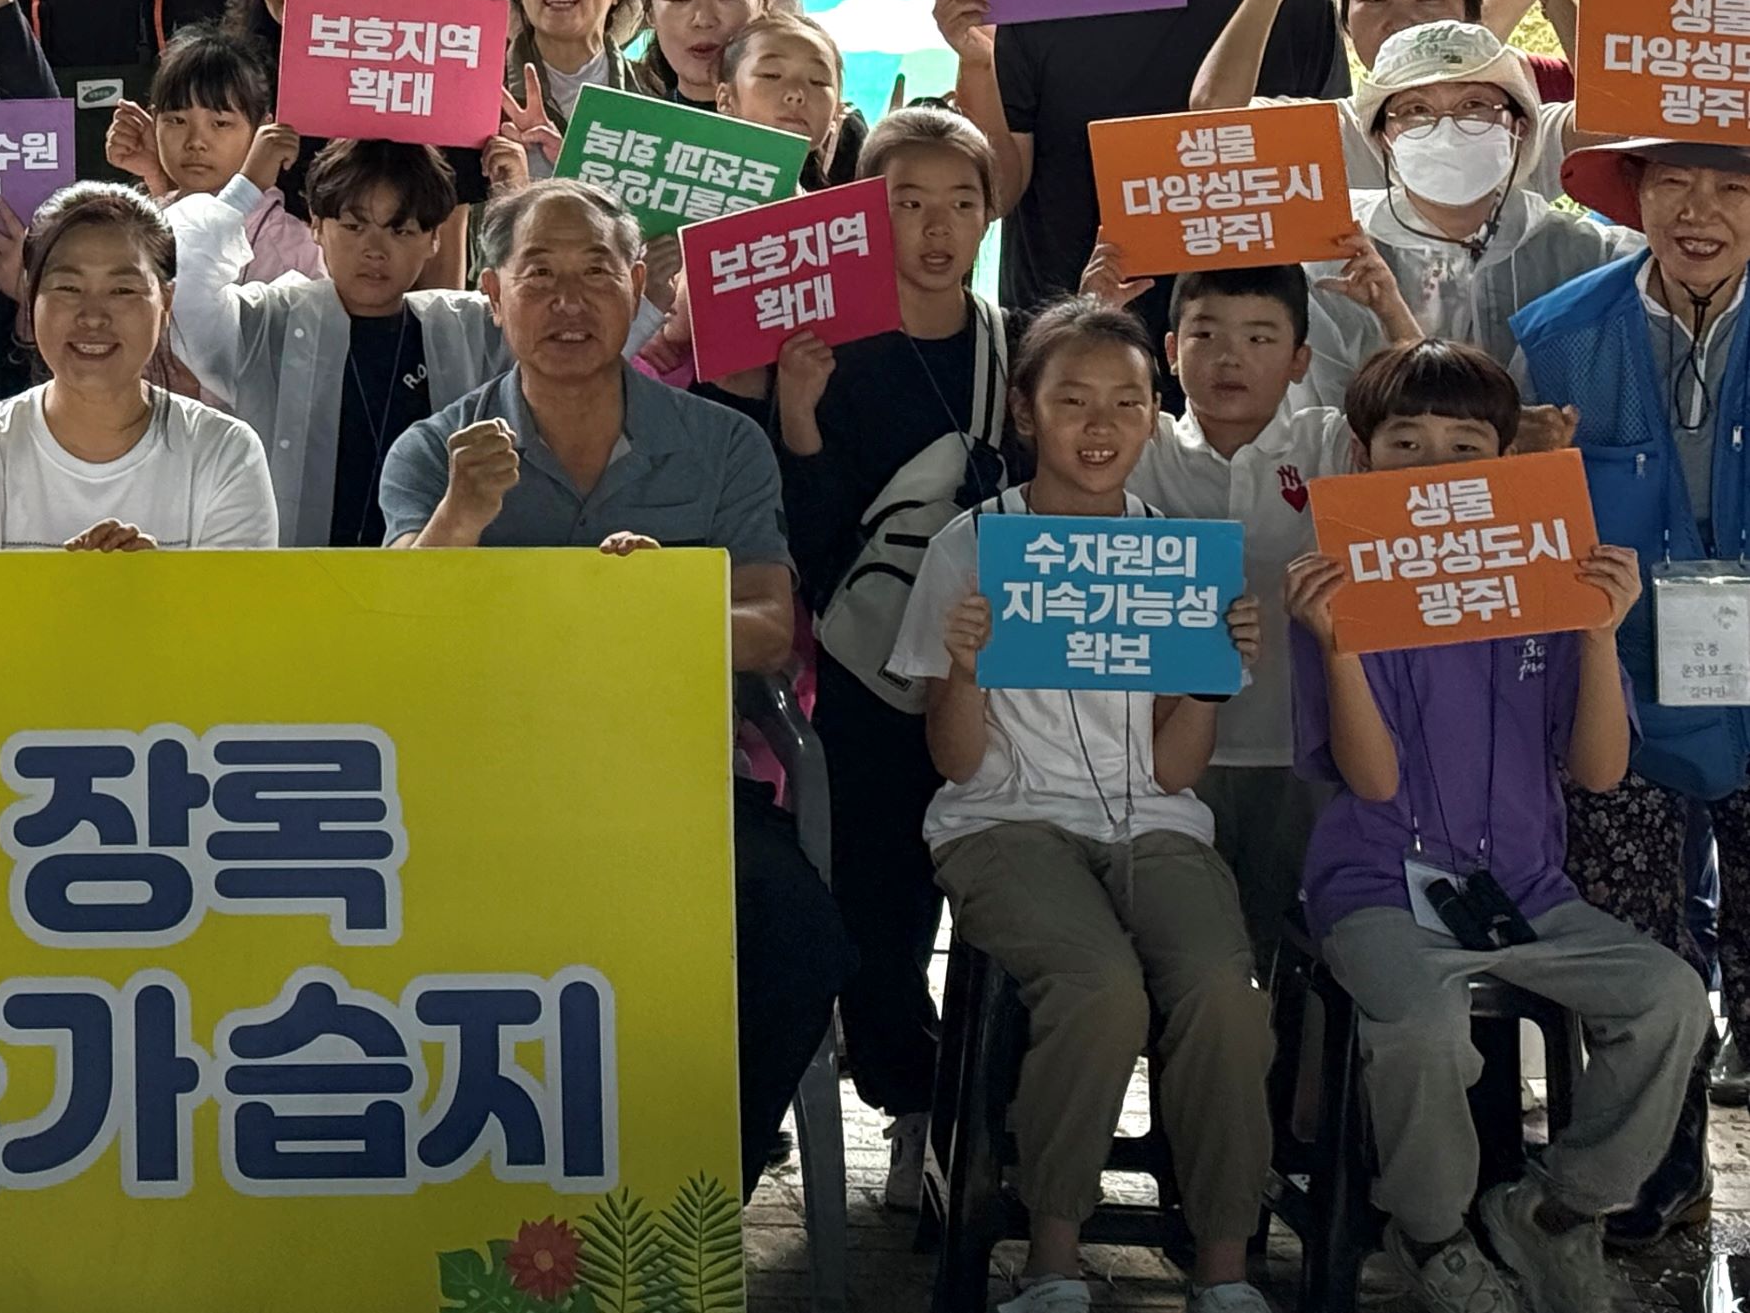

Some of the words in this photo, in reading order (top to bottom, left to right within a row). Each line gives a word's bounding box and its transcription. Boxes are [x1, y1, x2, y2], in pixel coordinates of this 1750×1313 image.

[308, 14, 481, 68] 보호지역
[348, 67, 434, 116] 확대
[1660, 84, 1750, 127] 광주
[1177, 125, 1256, 167] 생물
[1122, 164, 1323, 215] 다양성도시
[710, 212, 869, 294] 보호지역
[1181, 212, 1275, 255] 광주!
[755, 273, 835, 329] 확대
[1406, 478, 1495, 526] 생물
[1024, 533, 1197, 578] 수자원의
[1349, 519, 1572, 582] 다양성도시
[1003, 582, 1218, 627] 지속가능성
[1416, 575, 1521, 626] 광주!
[1066, 631, 1151, 675] 확보
[13, 738, 394, 933] 장록
